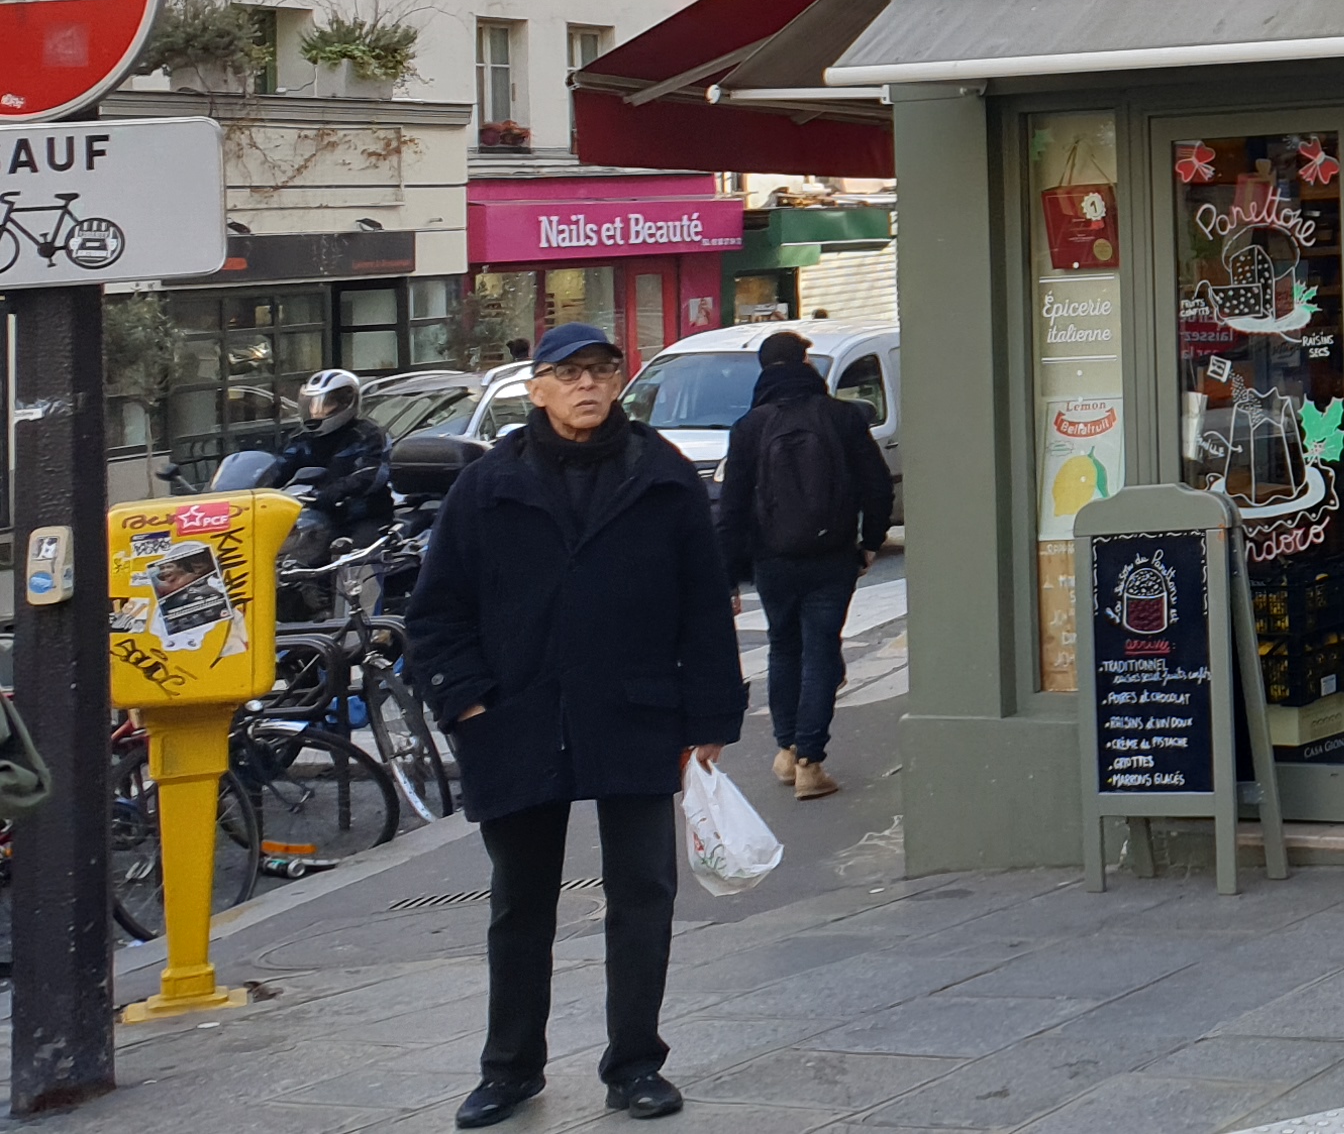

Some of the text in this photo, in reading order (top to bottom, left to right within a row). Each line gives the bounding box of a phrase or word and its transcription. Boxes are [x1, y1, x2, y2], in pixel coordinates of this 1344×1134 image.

[0, 134, 110, 175] AUF
[1196, 185, 1317, 247] Panettone
[538, 212, 703, 248] Nails et Beauté
[1043, 290, 1112, 326] Épicerie
[1180, 299, 1205, 309] FRUITS
[1047, 324, 1112, 344] italienne
[1302, 332, 1335, 347] RAISINS
[1308, 347, 1331, 358] SECS
[1066, 399, 1107, 413] Lemon
[202, 515, 230, 527] PCF
[1244, 516, 1330, 563] ndoro
